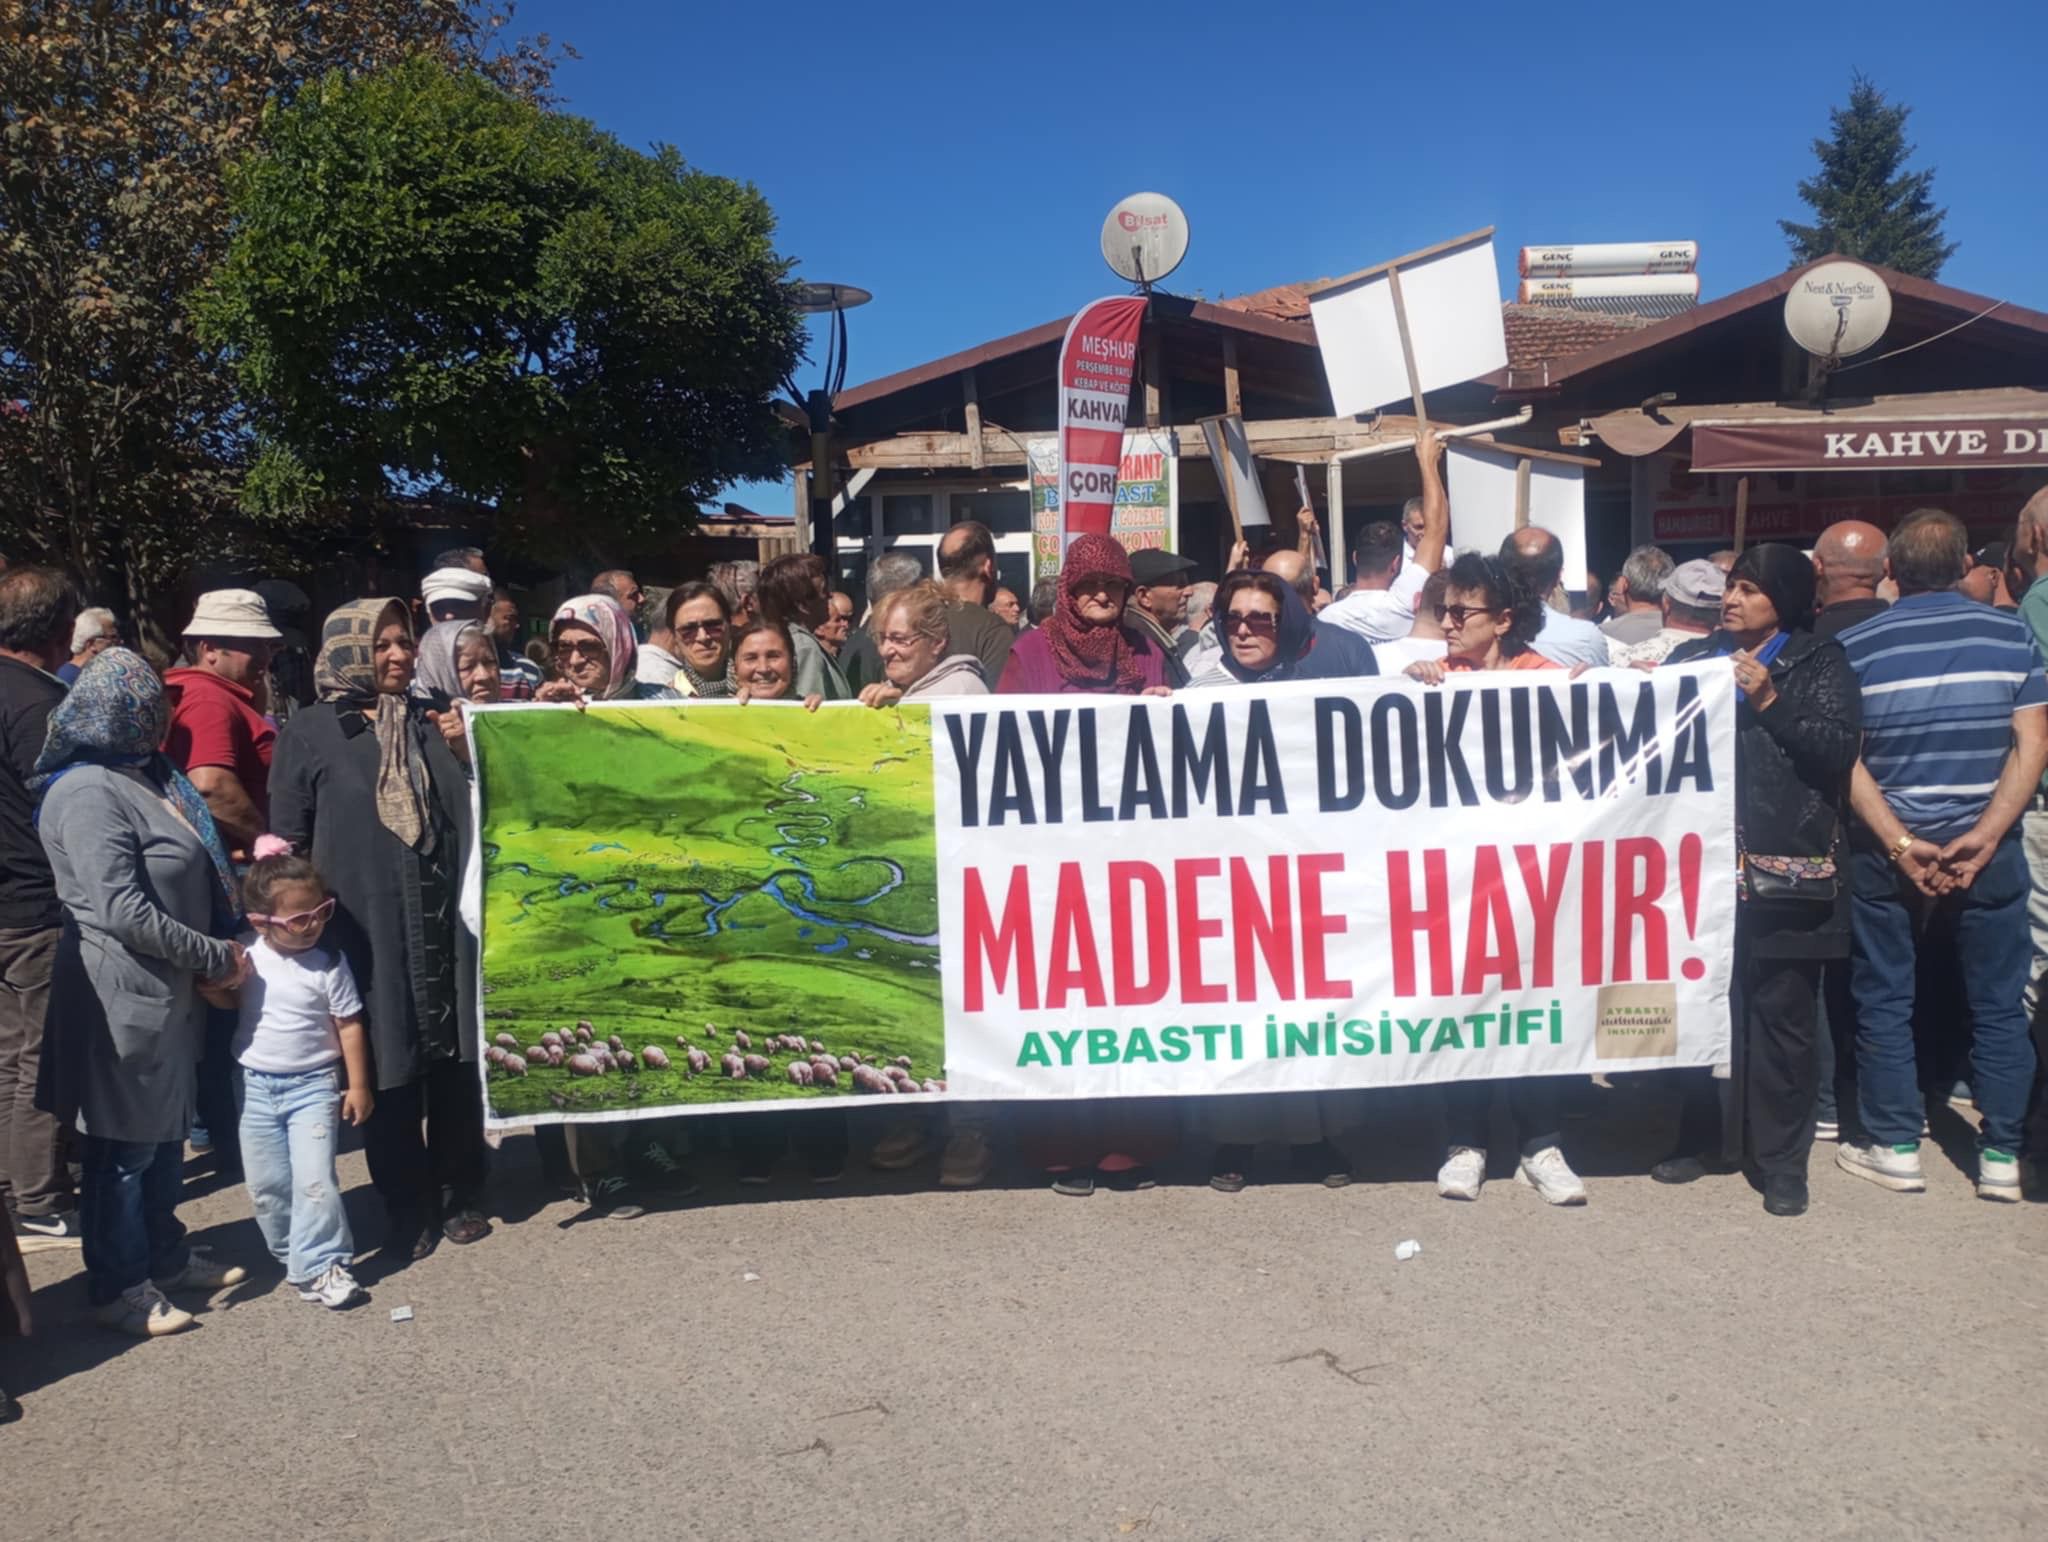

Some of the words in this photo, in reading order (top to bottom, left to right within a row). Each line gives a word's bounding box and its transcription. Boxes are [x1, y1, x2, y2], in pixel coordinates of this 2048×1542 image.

[1082, 336, 1136, 361] MEŞHUR
[1824, 430, 1988, 458] KAHVE
[1747, 508, 1795, 530] AHVE
[944, 699, 1288, 827] YAYLAMA
[1315, 675, 1713, 812] DOKUNMA
[963, 852, 1353, 1012] MADENE
[1386, 832, 1706, 997] HAYIR!
[1016, 1024, 1243, 1067] AYBASTI
[1266, 1000, 1562, 1058] İNİSİYATİFİ
